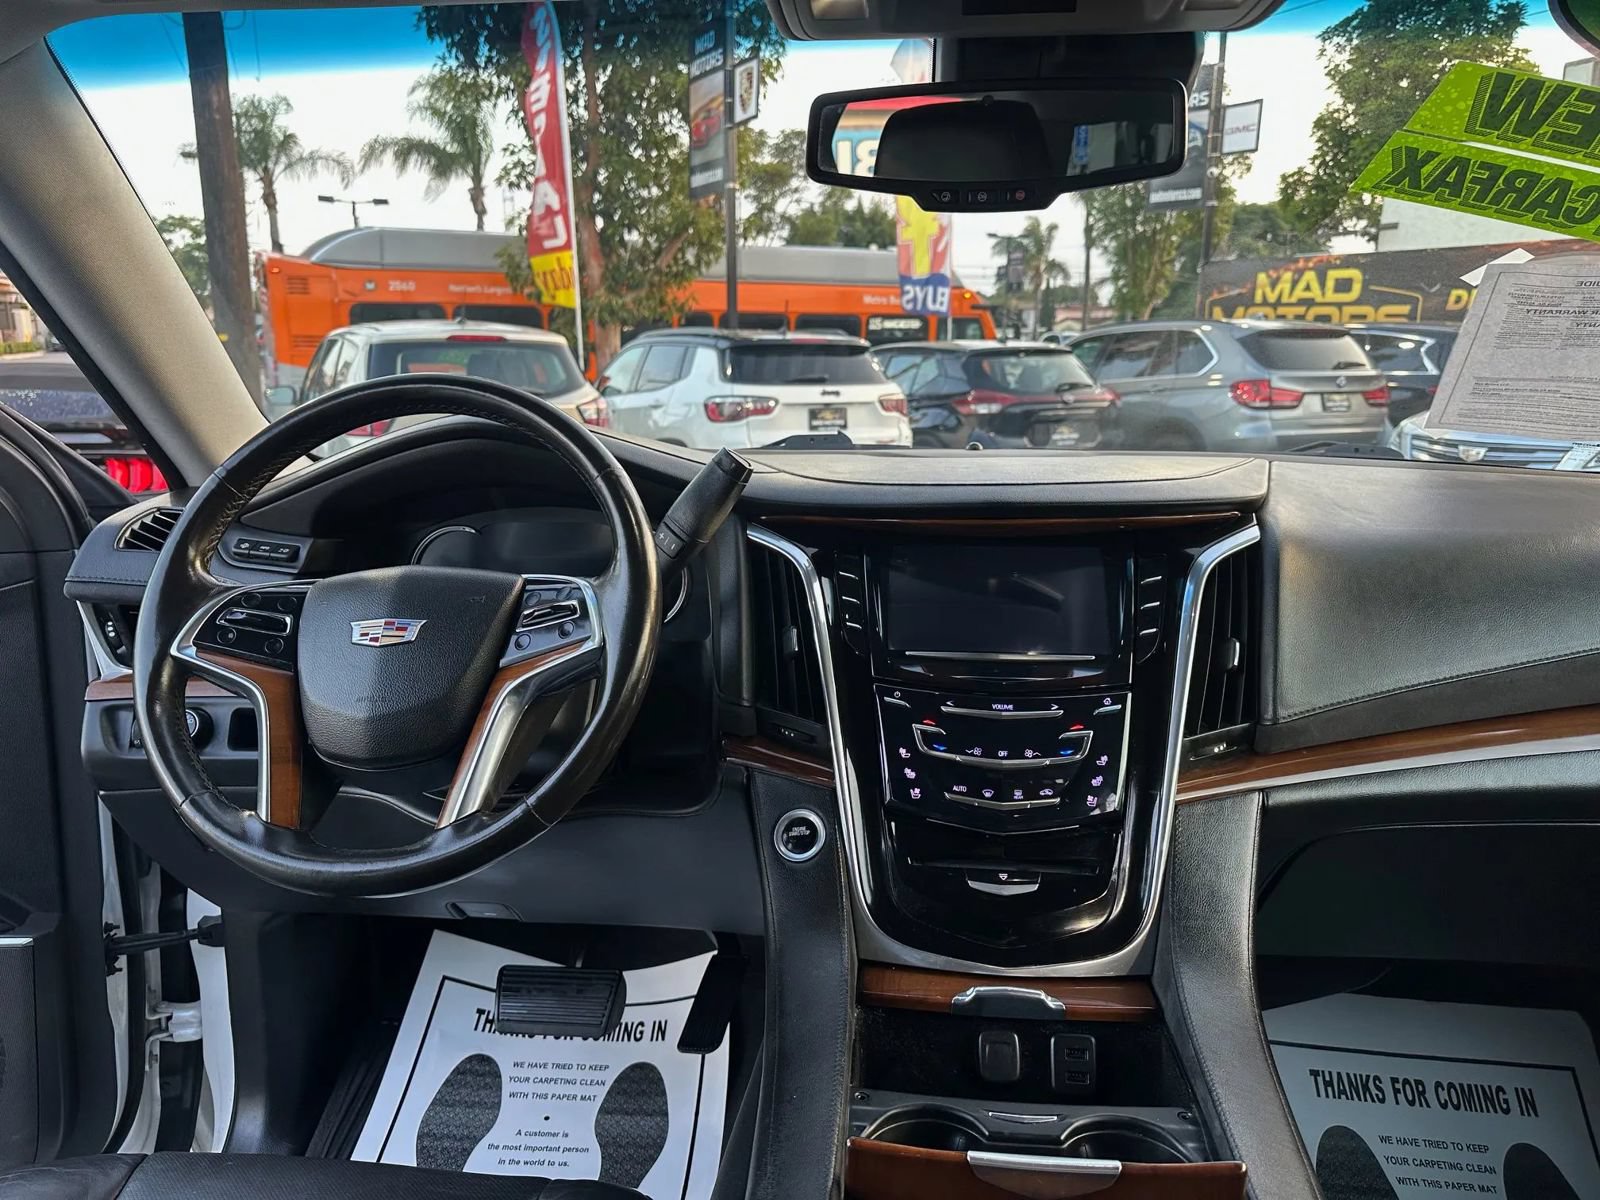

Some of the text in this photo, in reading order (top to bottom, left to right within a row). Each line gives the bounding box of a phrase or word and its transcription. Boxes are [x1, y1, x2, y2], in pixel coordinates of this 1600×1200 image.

[1225, 123, 1257, 136] GMC
[1254, 267, 1363, 305] MAD
[992, 703, 1014, 711] VOLUME
[952, 785, 967, 793] AUTO
[649, 1020, 668, 1042] IN
[512, 1061, 610, 1072] WE HAVE TRIED TO KEEP
[508, 1076, 606, 1087] YOUR CARPETING CLEAN
[509, 1091, 598, 1102] WITH THIS PAPER MAT
[1308, 1068, 1540, 1118] THANKS FOR COMING IN
[515, 1129, 569, 1138] A customer is
[523, 1143, 561, 1153] important
[1378, 1134, 1490, 1154] WE HAVE TRIED TO KEEP
[1383, 1155, 1497, 1175] YOUR CARPETING CLEAN
[1395, 1176, 1498, 1194] WITH THIS PAPER MAT
